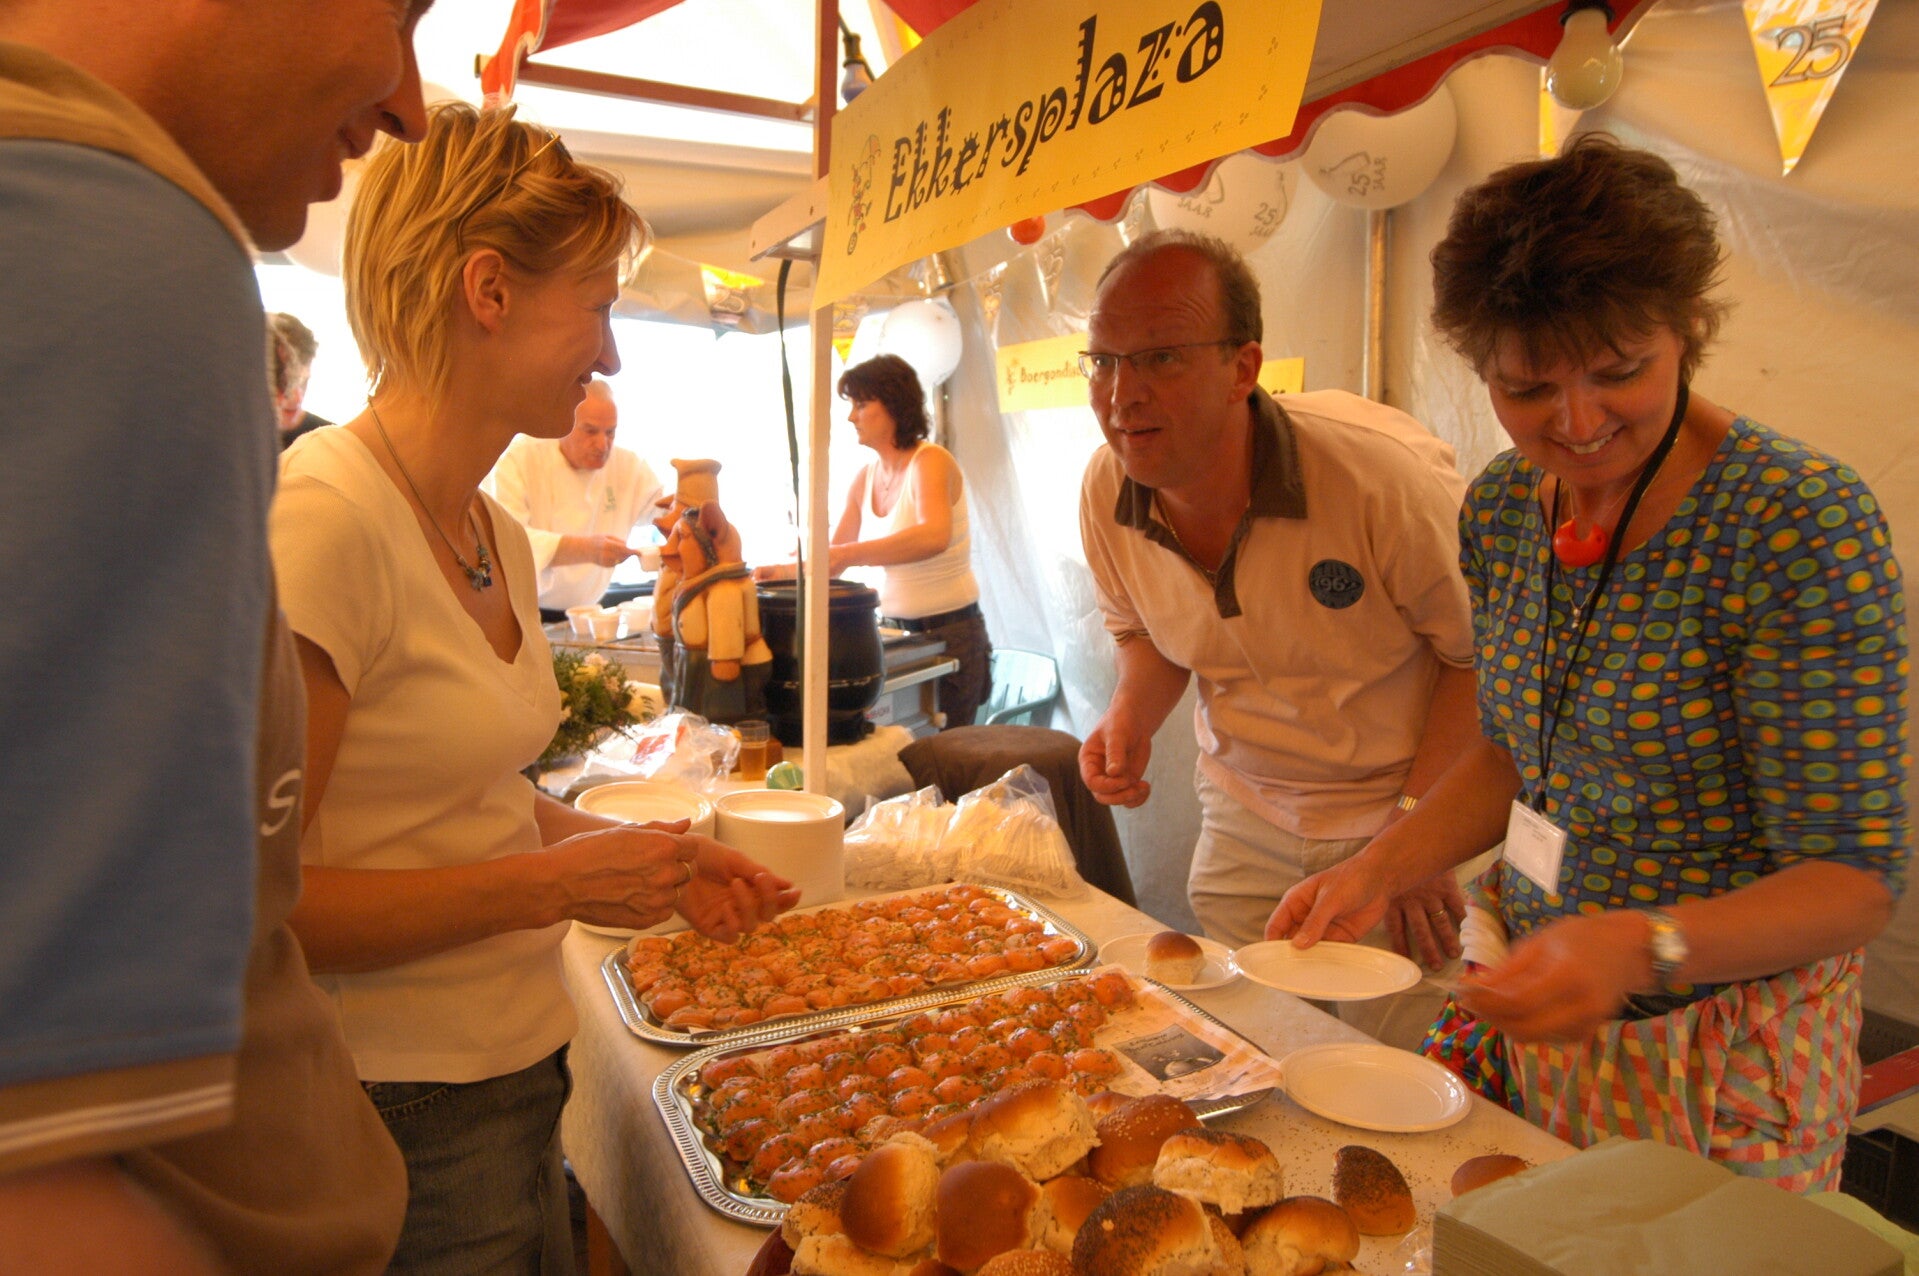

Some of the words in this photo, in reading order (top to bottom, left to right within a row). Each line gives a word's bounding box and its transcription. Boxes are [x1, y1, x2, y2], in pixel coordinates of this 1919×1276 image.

[1768, 14, 1851, 87] 25
[884, 1, 1224, 223] Ekkersplaza
[1348, 173, 1372, 197] 25
[1254, 202, 1277, 225] 25
